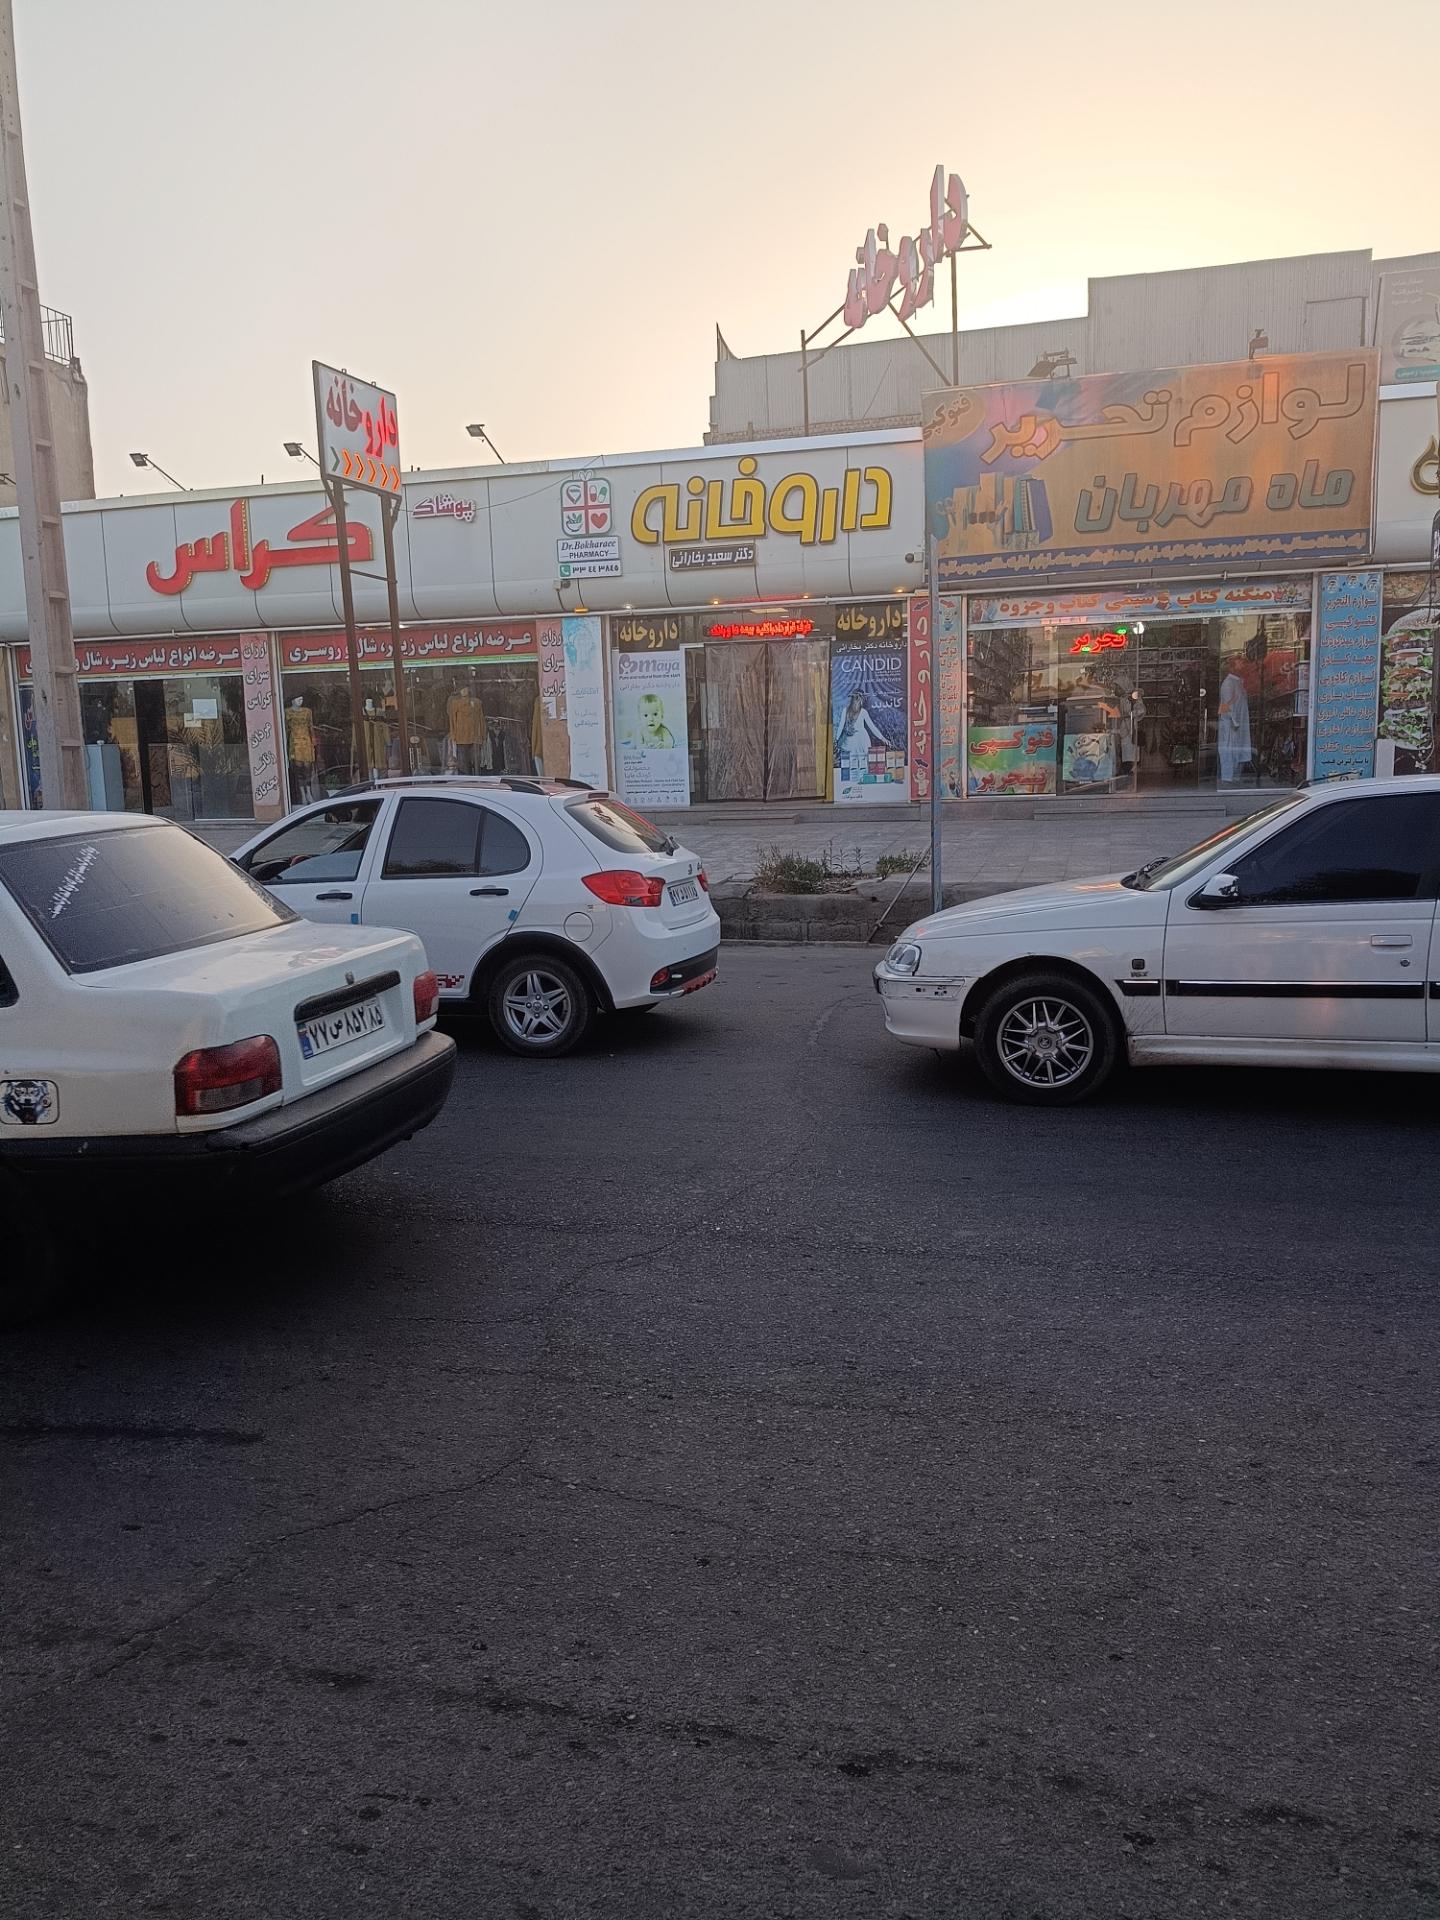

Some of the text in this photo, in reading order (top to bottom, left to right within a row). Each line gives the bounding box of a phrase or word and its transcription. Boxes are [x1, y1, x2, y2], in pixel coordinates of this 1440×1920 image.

[326, 375, 398, 460] داروخانه
[980, 363, 1366, 464] لوازم تحریر
[1265, 458, 1355, 512] ماه
[412, 494, 476, 522] پوشاک
[631, 456, 893, 544] داروخانه
[1074, 473, 1254, 534] مهربان
[146, 498, 375, 596] کراس
[569, 550, 609, 559] PHARMACY
[735, 547, 754, 562] دکتر
[707, 552, 733, 565] سعید
[1177, 588, 1221, 609] کتاب
[837, 604, 902, 637] داروخانه
[452, 631, 484, 653] انواع
[487, 630, 532, 651] عرضه
[620, 616, 678, 649] داروخانه
[1071, 626, 1126, 653] تحریر
[199, 645, 239, 665] عرضه
[289, 646, 341, 663] روسری
[418, 633, 449, 655] لباس
[82, 651, 103, 671] شال
[139, 647, 166, 669] لباس
[169, 645, 197, 668] انواع
[841, 658, 902, 673] CANDID
[245, 667, 269, 685] سرای
[913, 616, 931, 754] داروخانه
